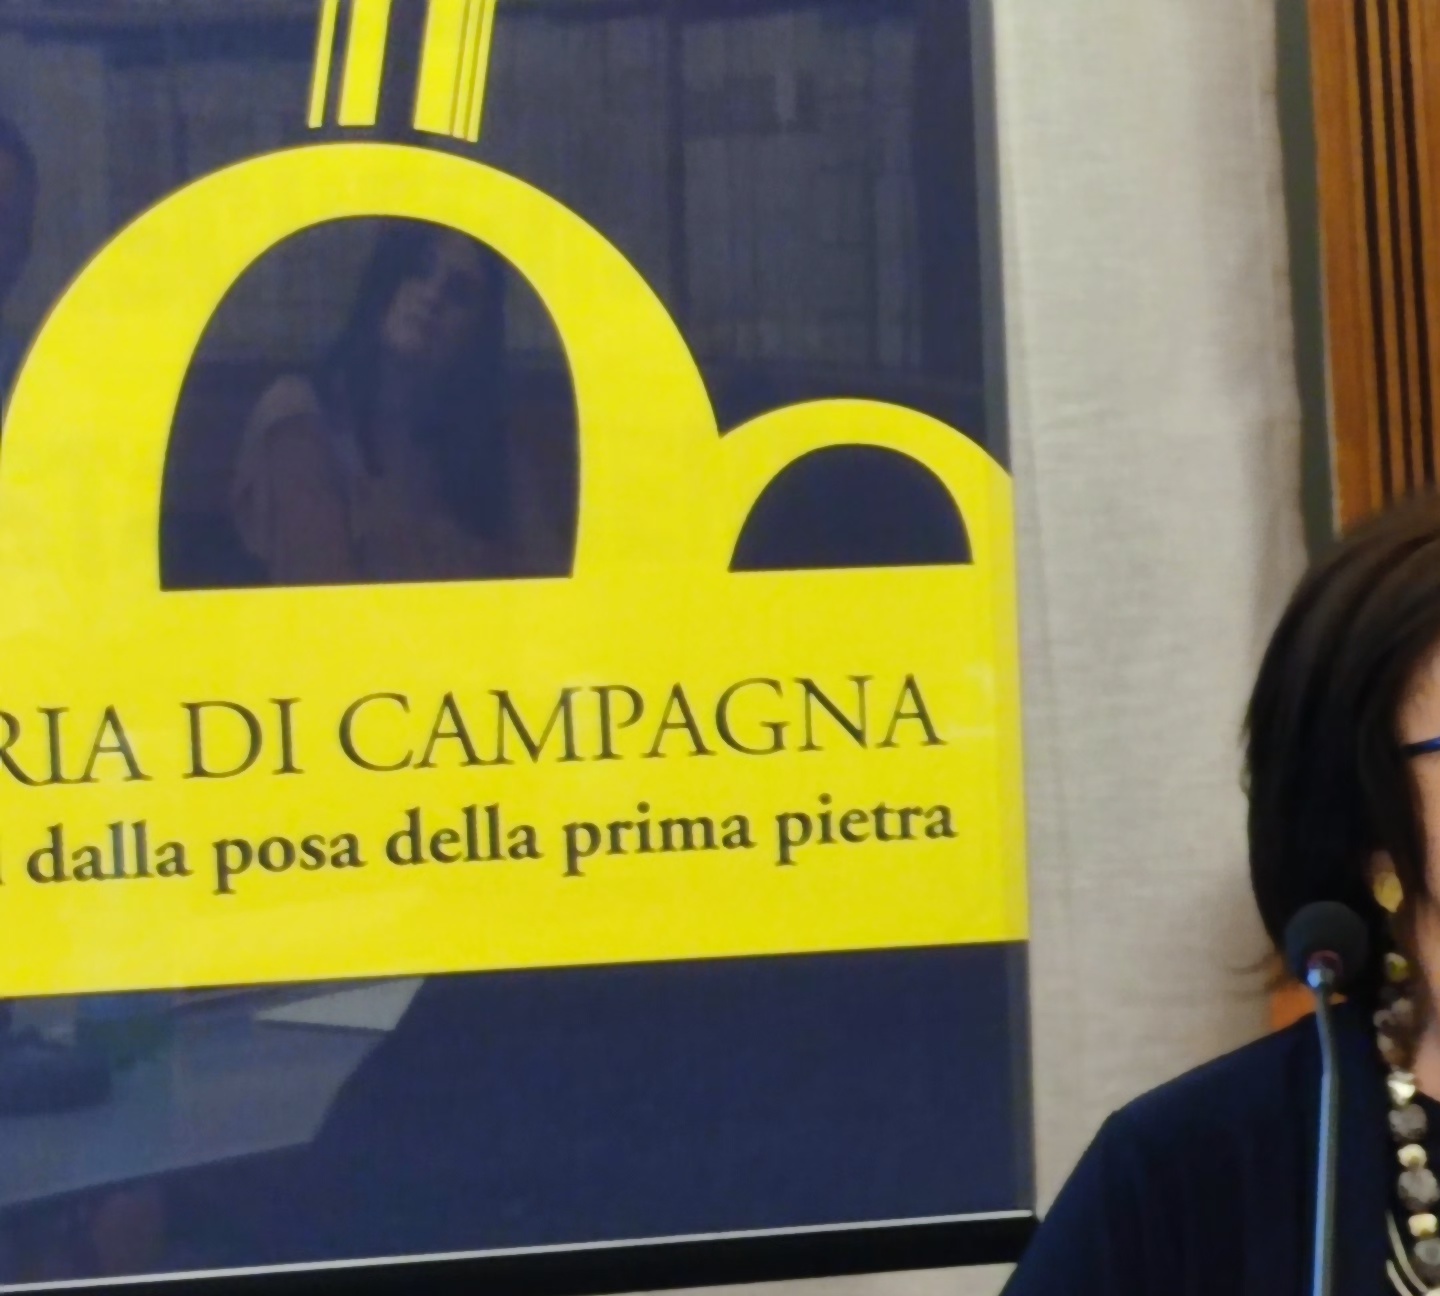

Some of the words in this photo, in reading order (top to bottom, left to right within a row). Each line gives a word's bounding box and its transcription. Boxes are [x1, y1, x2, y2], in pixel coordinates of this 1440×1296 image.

[180, 696, 304, 780] DI
[338, 672, 949, 772] CAMPAGNA
[26, 819, 194, 884] dalla
[212, 832, 368, 896] posa
[385, 802, 545, 867] della
[562, 800, 757, 878] prima
[775, 792, 959, 867] pietra
